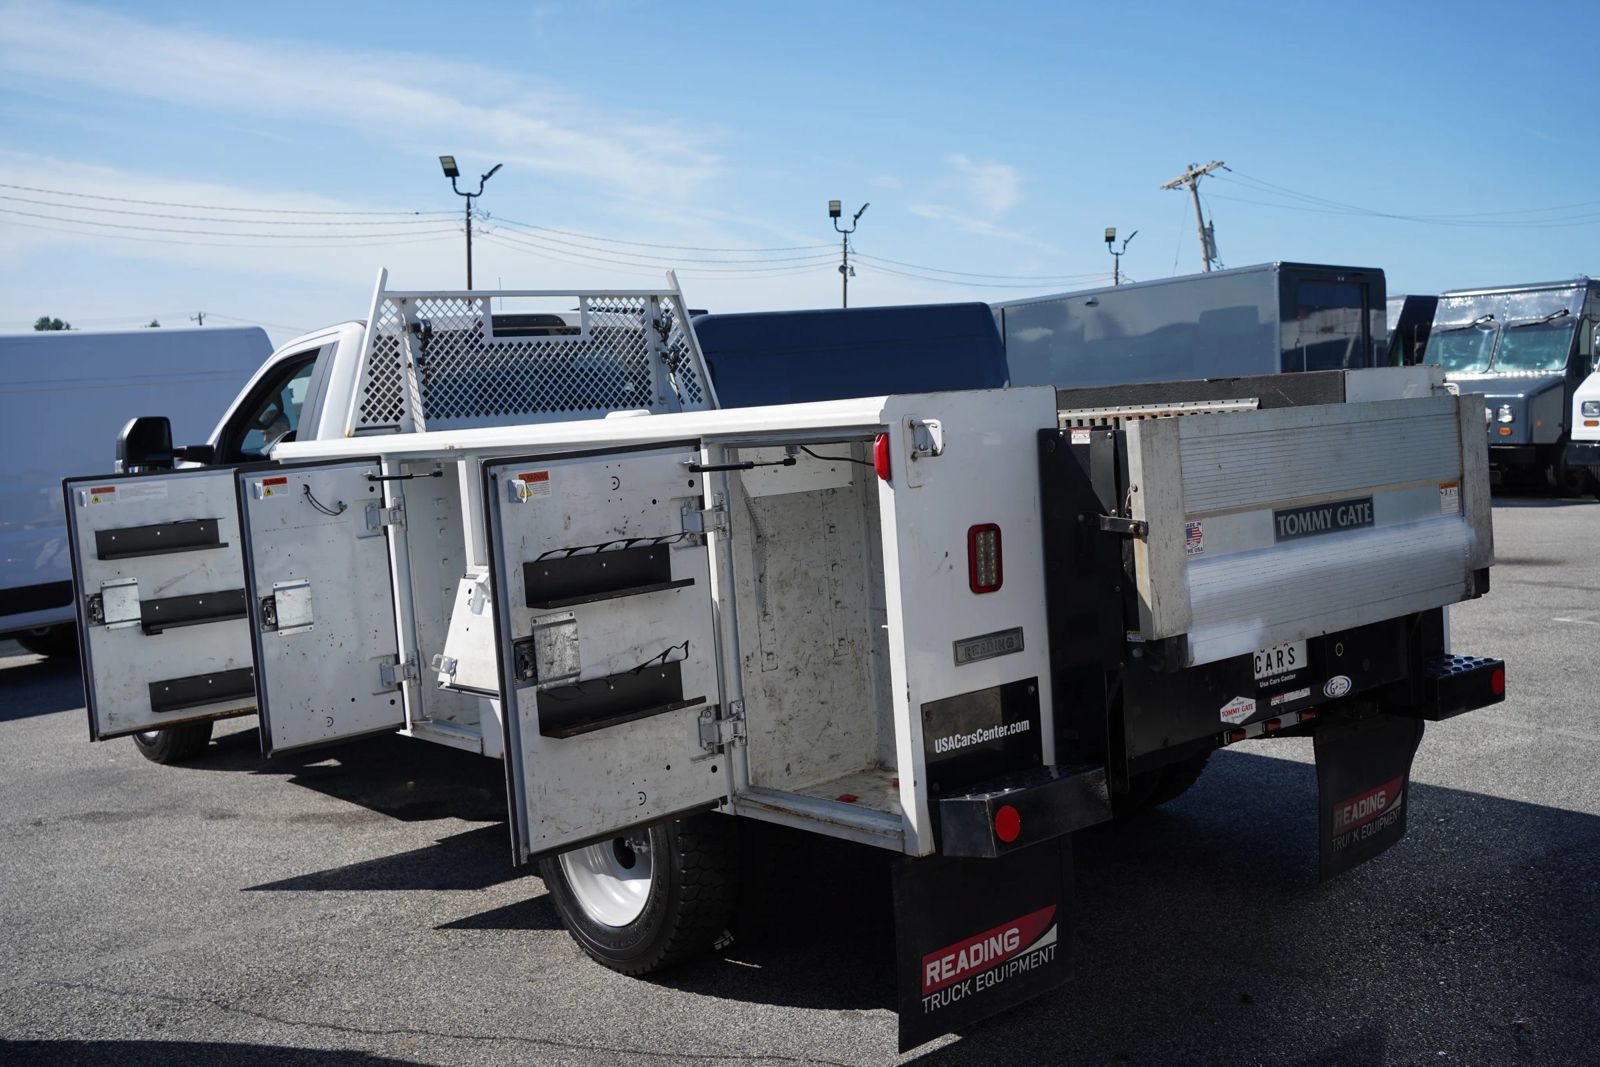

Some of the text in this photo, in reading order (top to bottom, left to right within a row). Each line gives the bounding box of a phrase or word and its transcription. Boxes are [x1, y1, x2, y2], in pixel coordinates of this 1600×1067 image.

[1278, 503, 1373, 537] TOMMY GATE
[964, 636, 1015, 658] READING
[1254, 646, 1296, 674] CARS
[1270, 678, 1280, 686] Cars
[1281, 673, 1296, 682] Center
[1221, 706, 1240, 718] TOMMY
[1241, 703, 1254, 712] GATE
[934, 719, 1030, 754] USACarsCenter.com
[1361, 806, 1401, 840] EQUIPMENT
[926, 927, 1020, 987] READING
[921, 943, 1058, 1014] TRUCK EQUIPMENT
